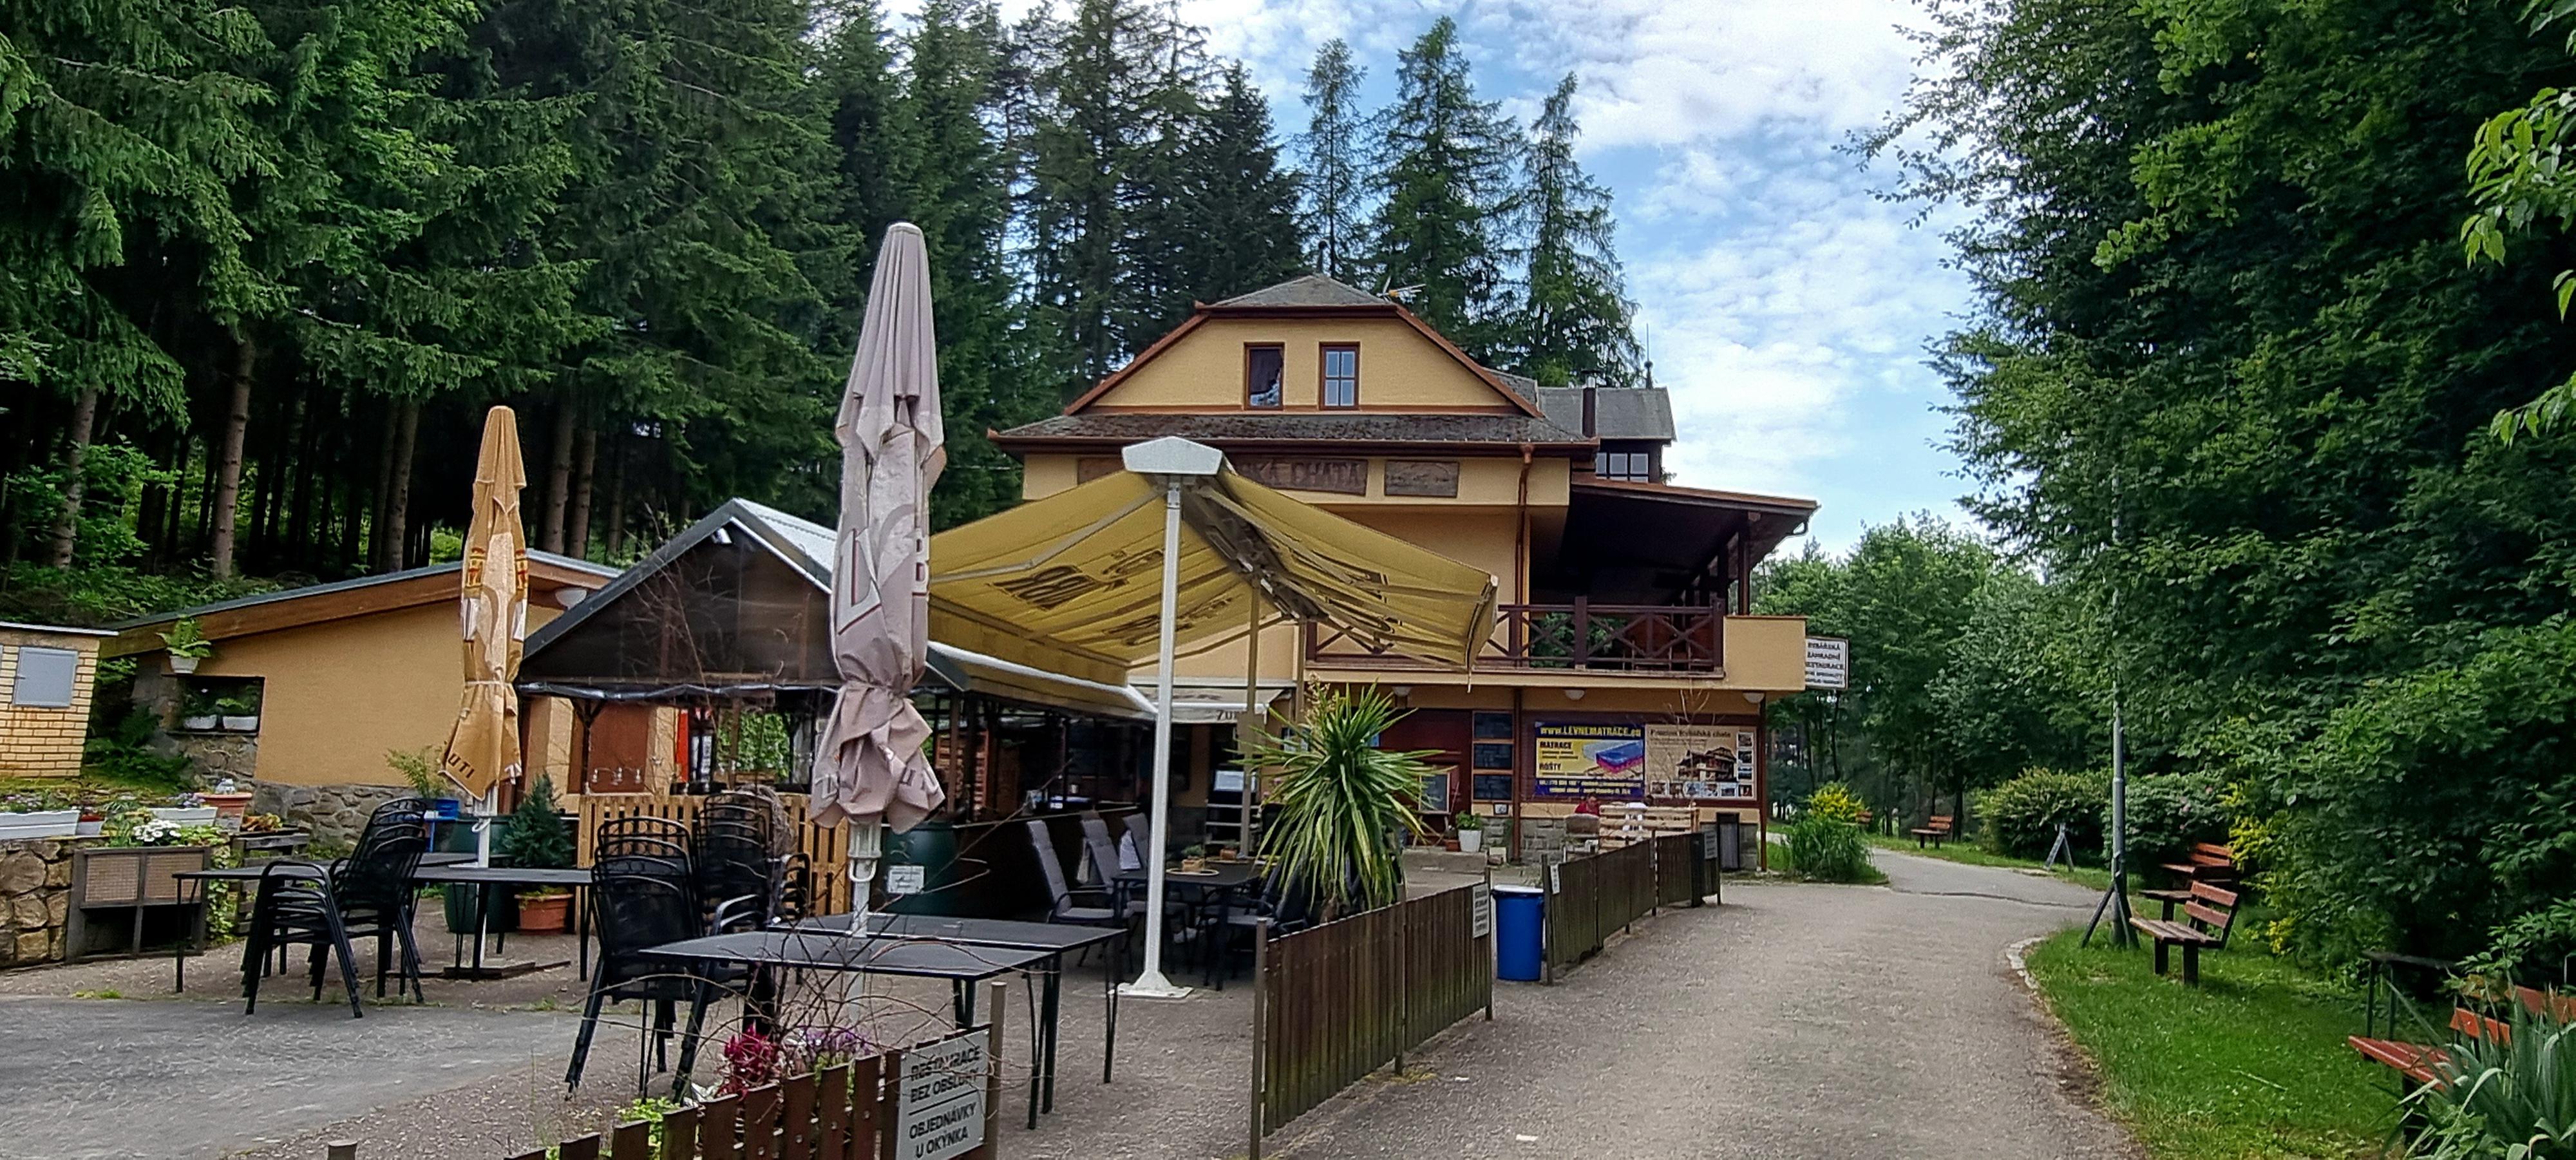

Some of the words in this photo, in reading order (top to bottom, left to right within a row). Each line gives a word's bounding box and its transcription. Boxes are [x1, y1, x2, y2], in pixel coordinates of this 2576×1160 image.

[1805, 661, 1844, 670] ESTAURACE
[1539, 762, 1561, 770] ROŠTY
[911, 1083, 931, 1103] BEZ
[909, 1102, 977, 1139] OBJEDNÁVKY
[916, 1143, 924, 1158] U
[926, 1126, 969, 1154] OKÝNKA
